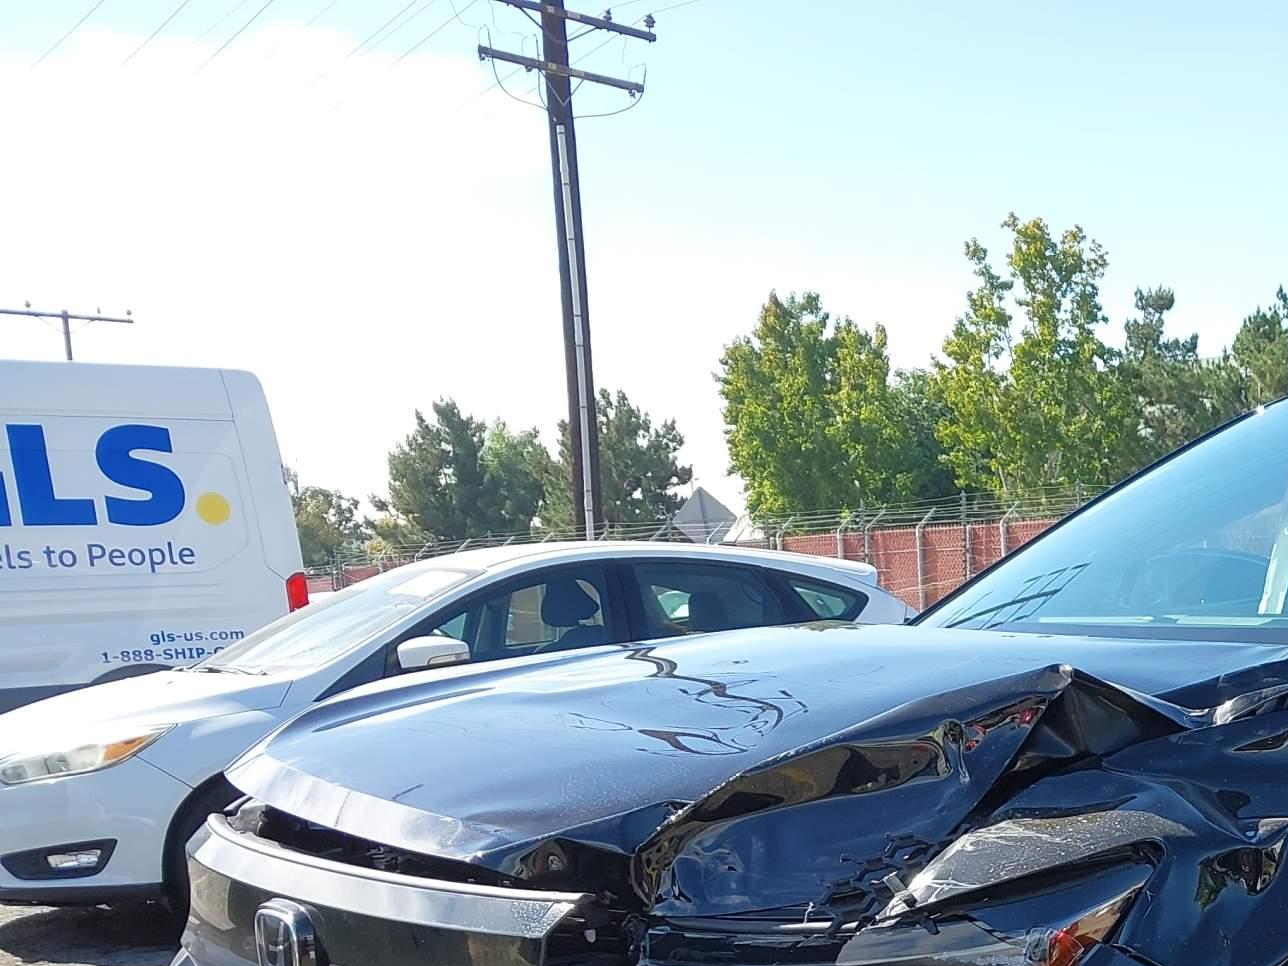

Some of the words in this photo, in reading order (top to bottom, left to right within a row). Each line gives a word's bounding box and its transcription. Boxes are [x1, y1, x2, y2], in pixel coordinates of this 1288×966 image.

[0, 544, 33, 570] ls
[43, 545, 78, 568] to
[87, 541, 196, 574] People
[150, 630, 245, 646] gls-us.com
